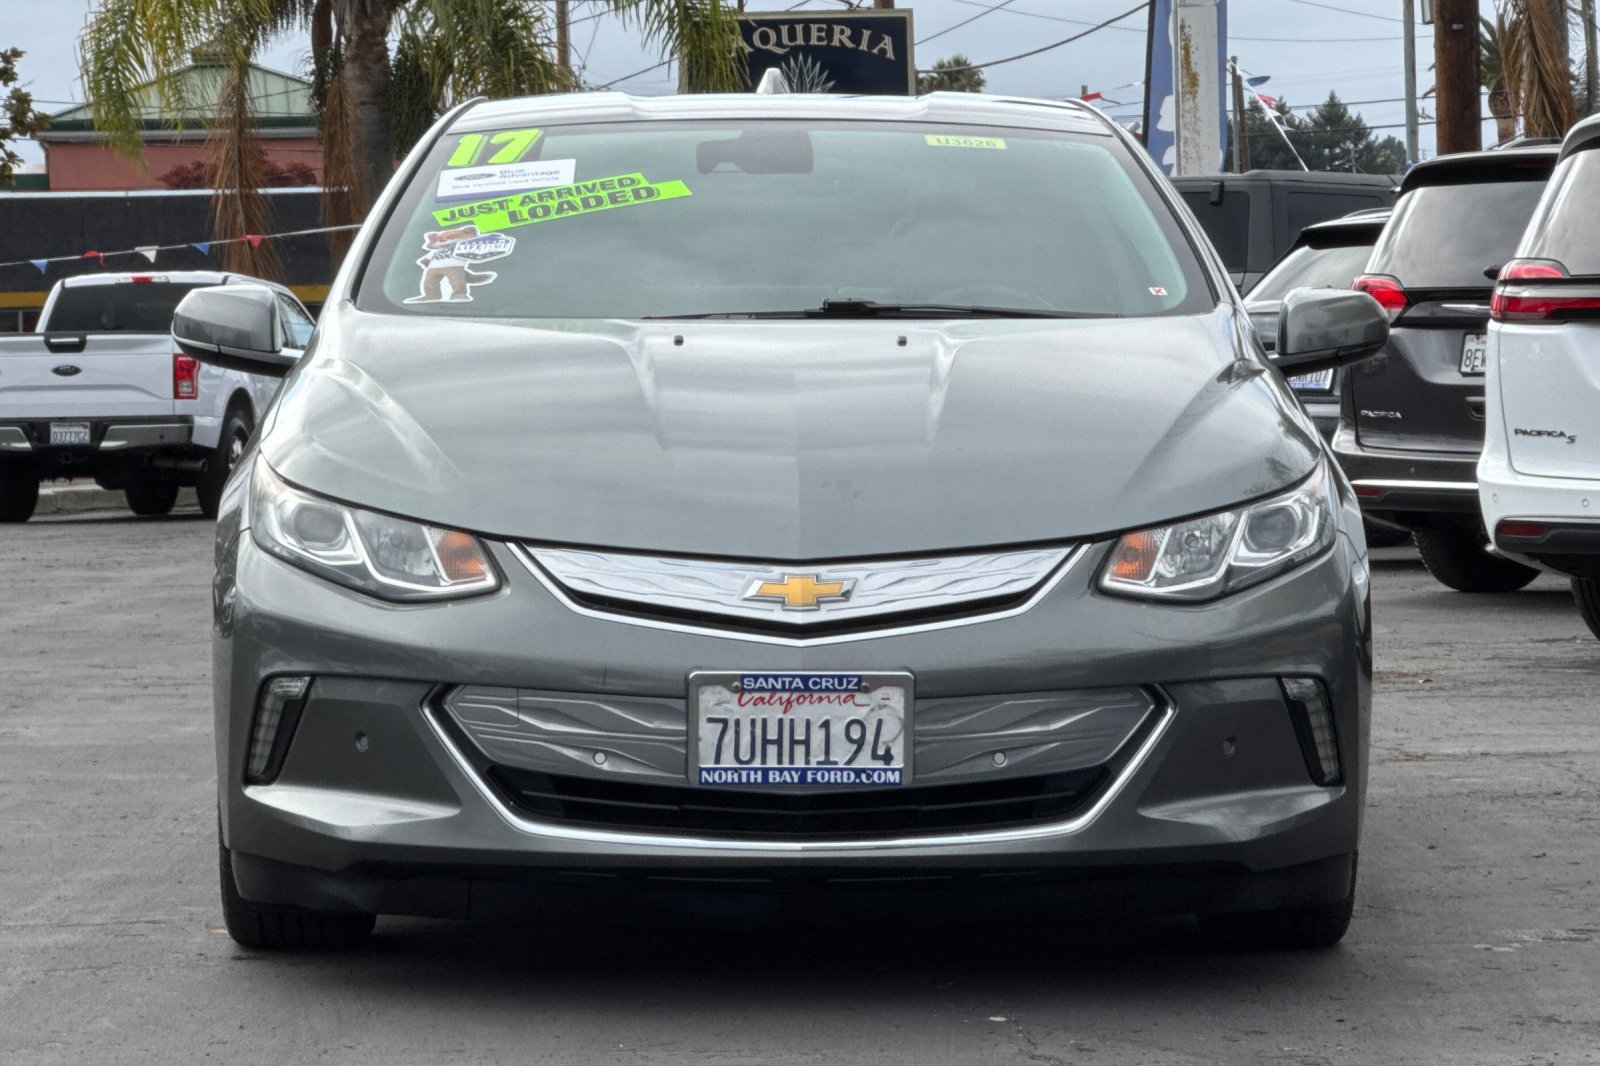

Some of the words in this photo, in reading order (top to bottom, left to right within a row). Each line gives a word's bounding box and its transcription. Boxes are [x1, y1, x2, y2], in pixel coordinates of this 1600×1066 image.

[731, 23, 896, 61] AQUERIA
[447, 129, 543, 166] 17
[499, 169, 560, 179] Advantage
[441, 199, 514, 222] JUST
[519, 176, 642, 207] ARRIVED
[507, 185, 660, 224] LOADED
[1360, 409, 1402, 419] PACIFICA
[1514, 428, 1567, 438] PACIFICA
[1566, 434, 1578, 444] S
[743, 677, 803, 690] SANTA
[808, 677, 859, 690] CRUZ
[737, 691, 871, 715] California
[706, 717, 895, 766] 7UHH194
[701, 770, 762, 784] NORTH
[768, 770, 801, 784] BAY
[807, 770, 900, 784] FORD.COM
